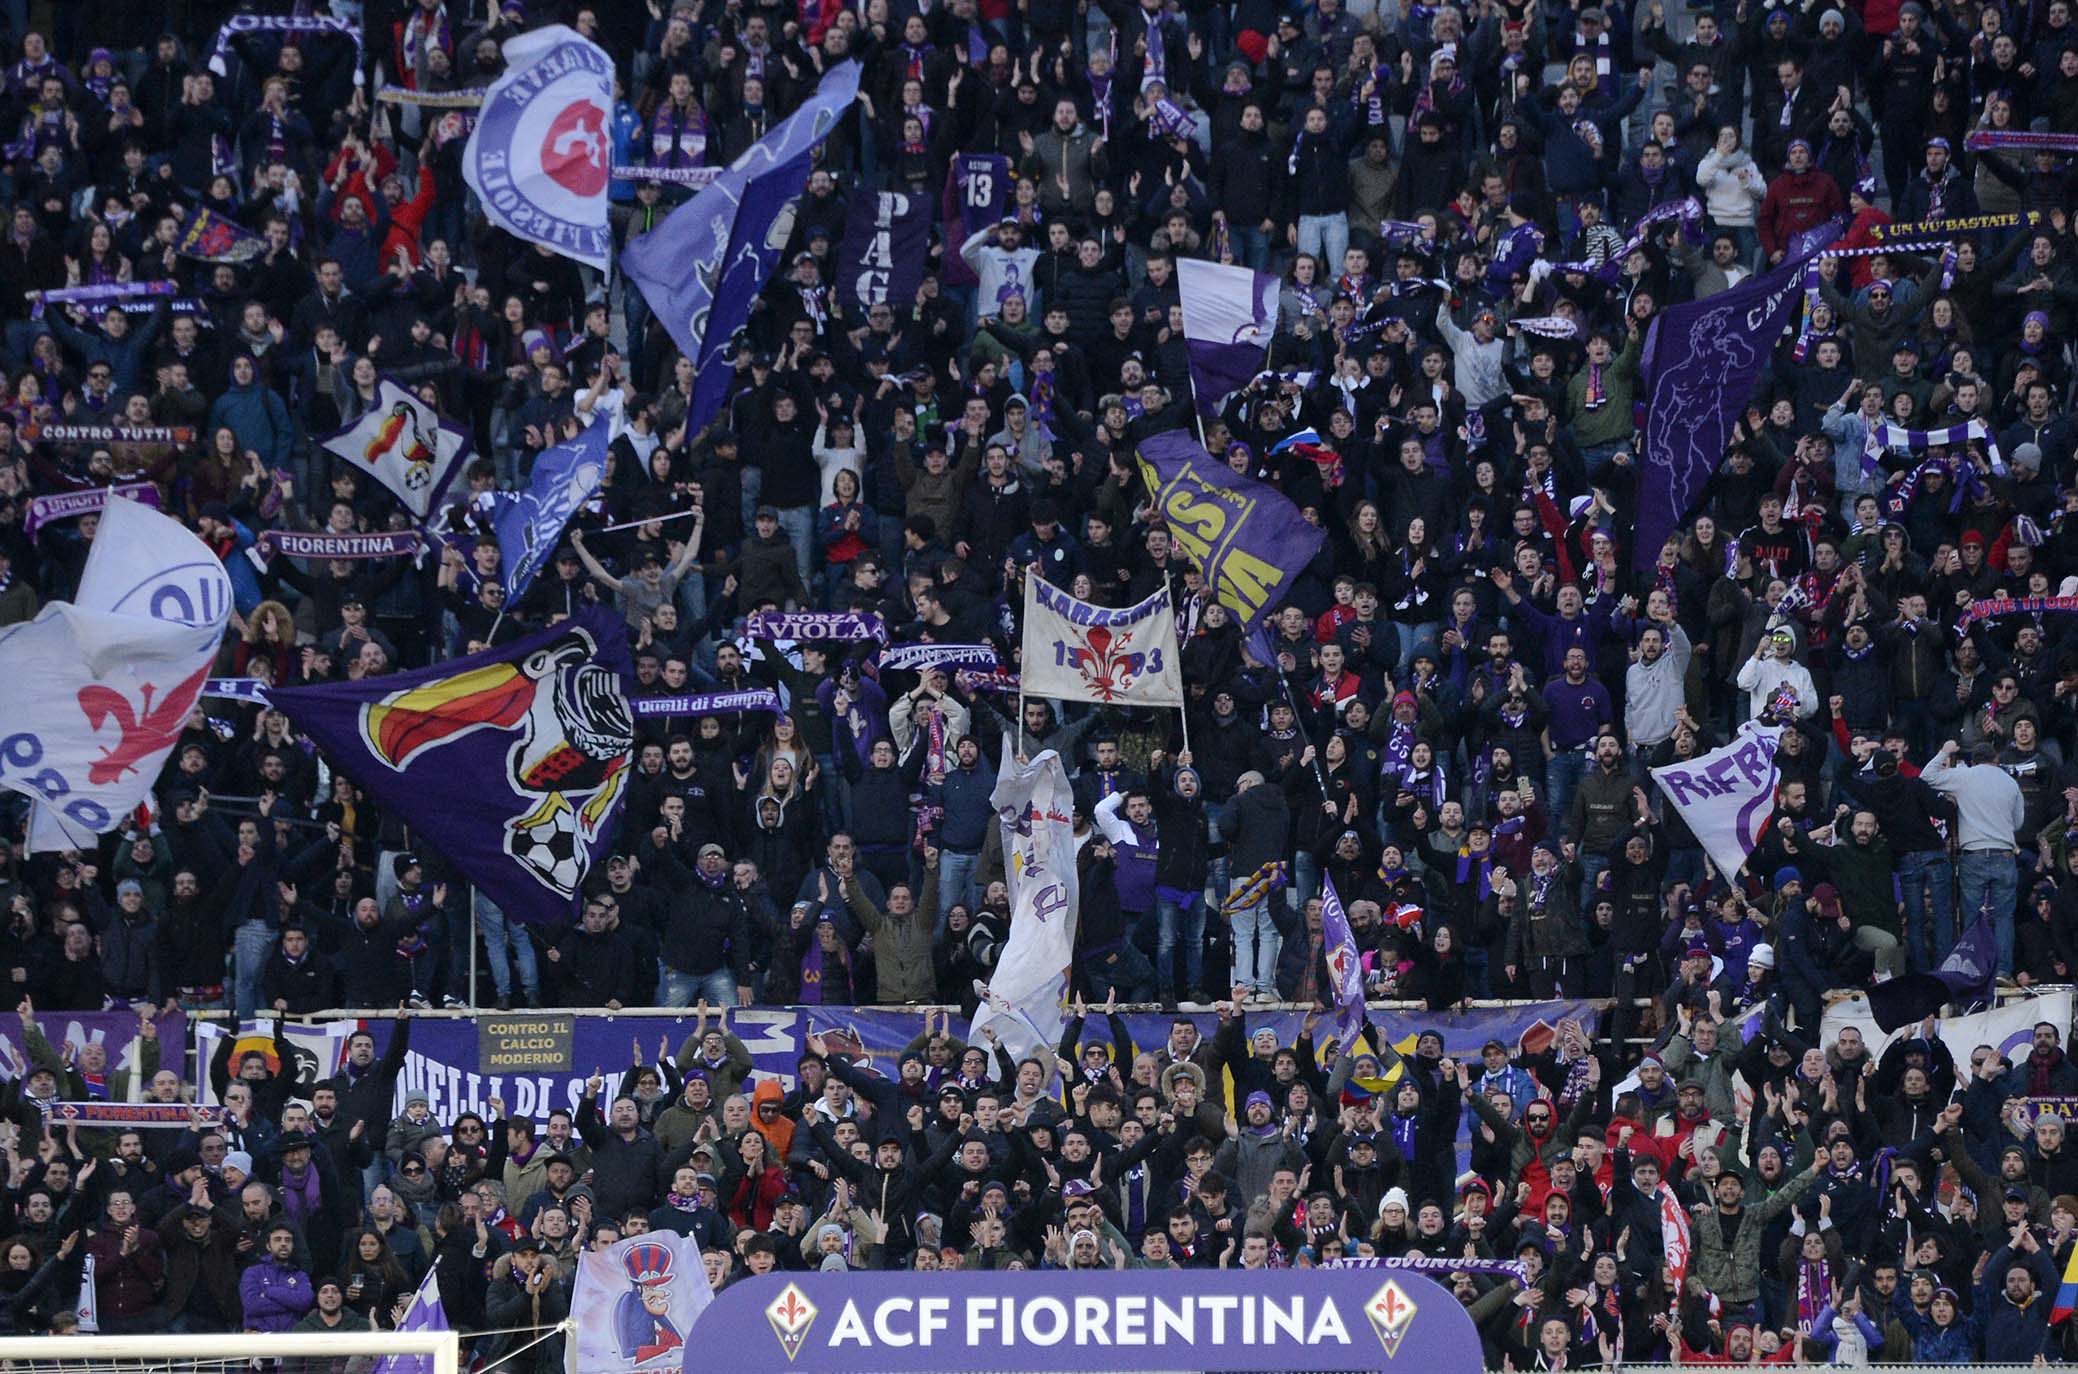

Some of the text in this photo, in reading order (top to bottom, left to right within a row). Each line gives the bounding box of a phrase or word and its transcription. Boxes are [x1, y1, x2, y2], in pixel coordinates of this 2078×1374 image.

[967, 173, 993, 208] 13
[42, 426, 171, 440] CONTRO TUTTI
[281, 536, 395, 553] FIORENTINA
[783, 613, 861, 623] FORZA
[766, 622, 870, 639] VIOLA
[888, 647, 998, 664] FIORENTINA
[638, 690, 777, 713] Quelli di Sempre
[487, 1022, 569, 1035] CONTRO IL
[500, 1038, 555, 1050] CALCIO
[490, 1052, 564, 1065] MODERNO
[514, 1076, 553, 1119] DI
[1385, 1255, 1495, 1269] OVUNQUE
[828, 1297, 1352, 1347] ACF FIORENTINA
